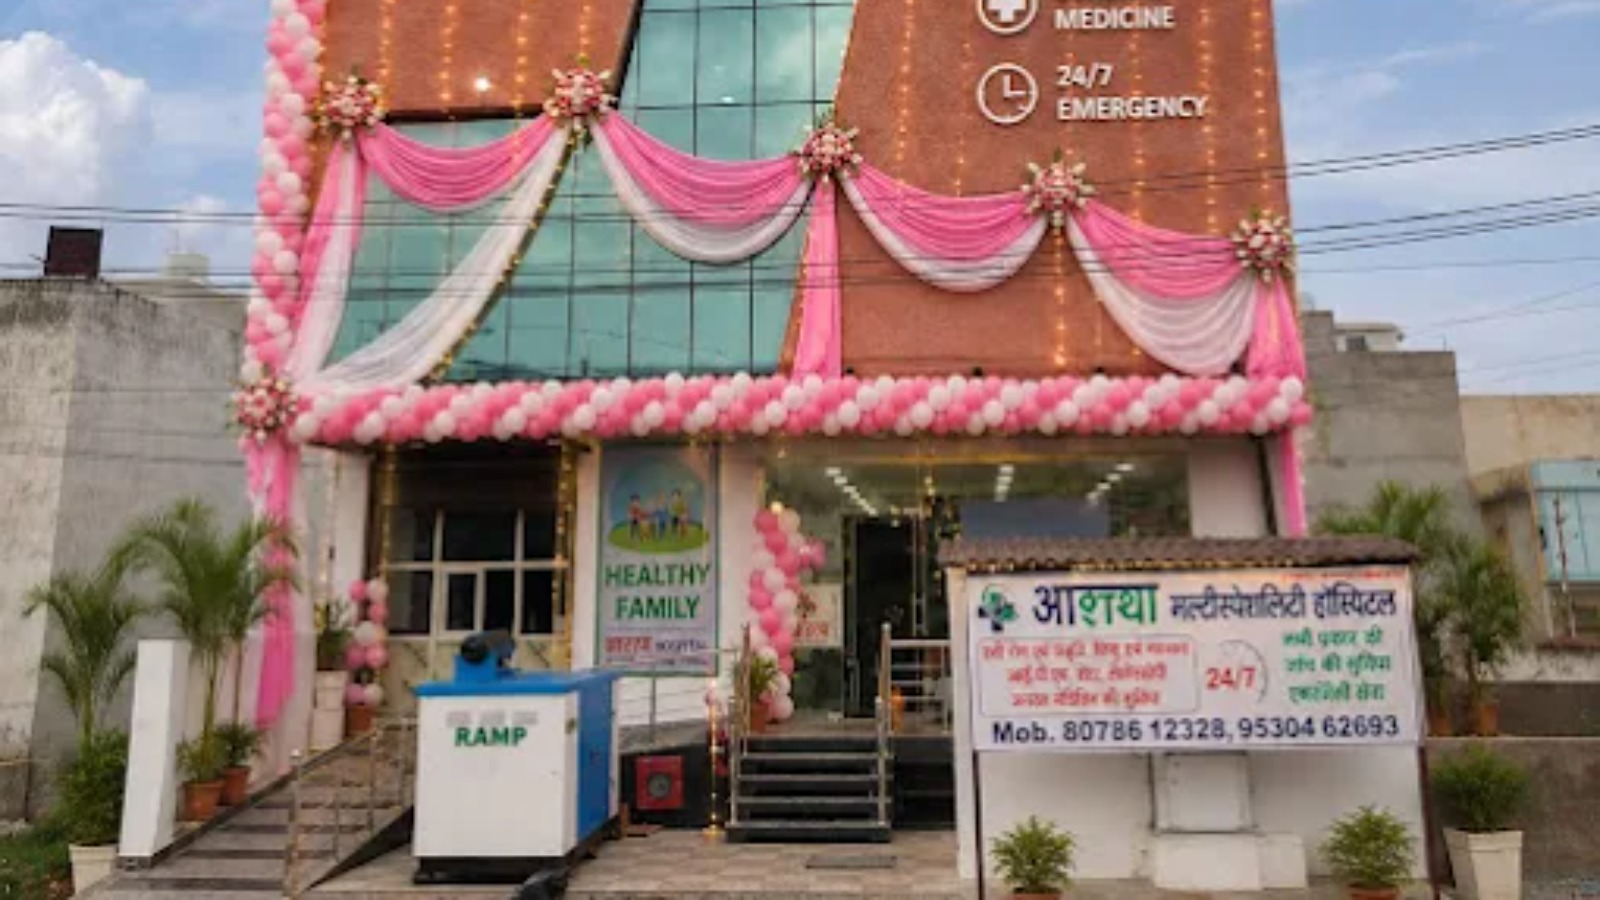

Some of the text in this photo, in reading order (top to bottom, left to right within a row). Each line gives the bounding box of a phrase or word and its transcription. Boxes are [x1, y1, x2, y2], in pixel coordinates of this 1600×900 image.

[1055, 7, 1176, 29] MEDICINE
[1057, 63, 1112, 88] 24/7
[1057, 96, 1208, 120] EMERGENCY
[605, 563, 710, 587] HEALTHY
[616, 595, 700, 619] FAMILY
[1204, 667, 1256, 690] 24/7
[455, 726, 528, 748] RAMP
[992, 719, 1056, 744] Mob.
[1062, 718, 1143, 743] 80786
[1321, 714, 1399, 738] 62693
